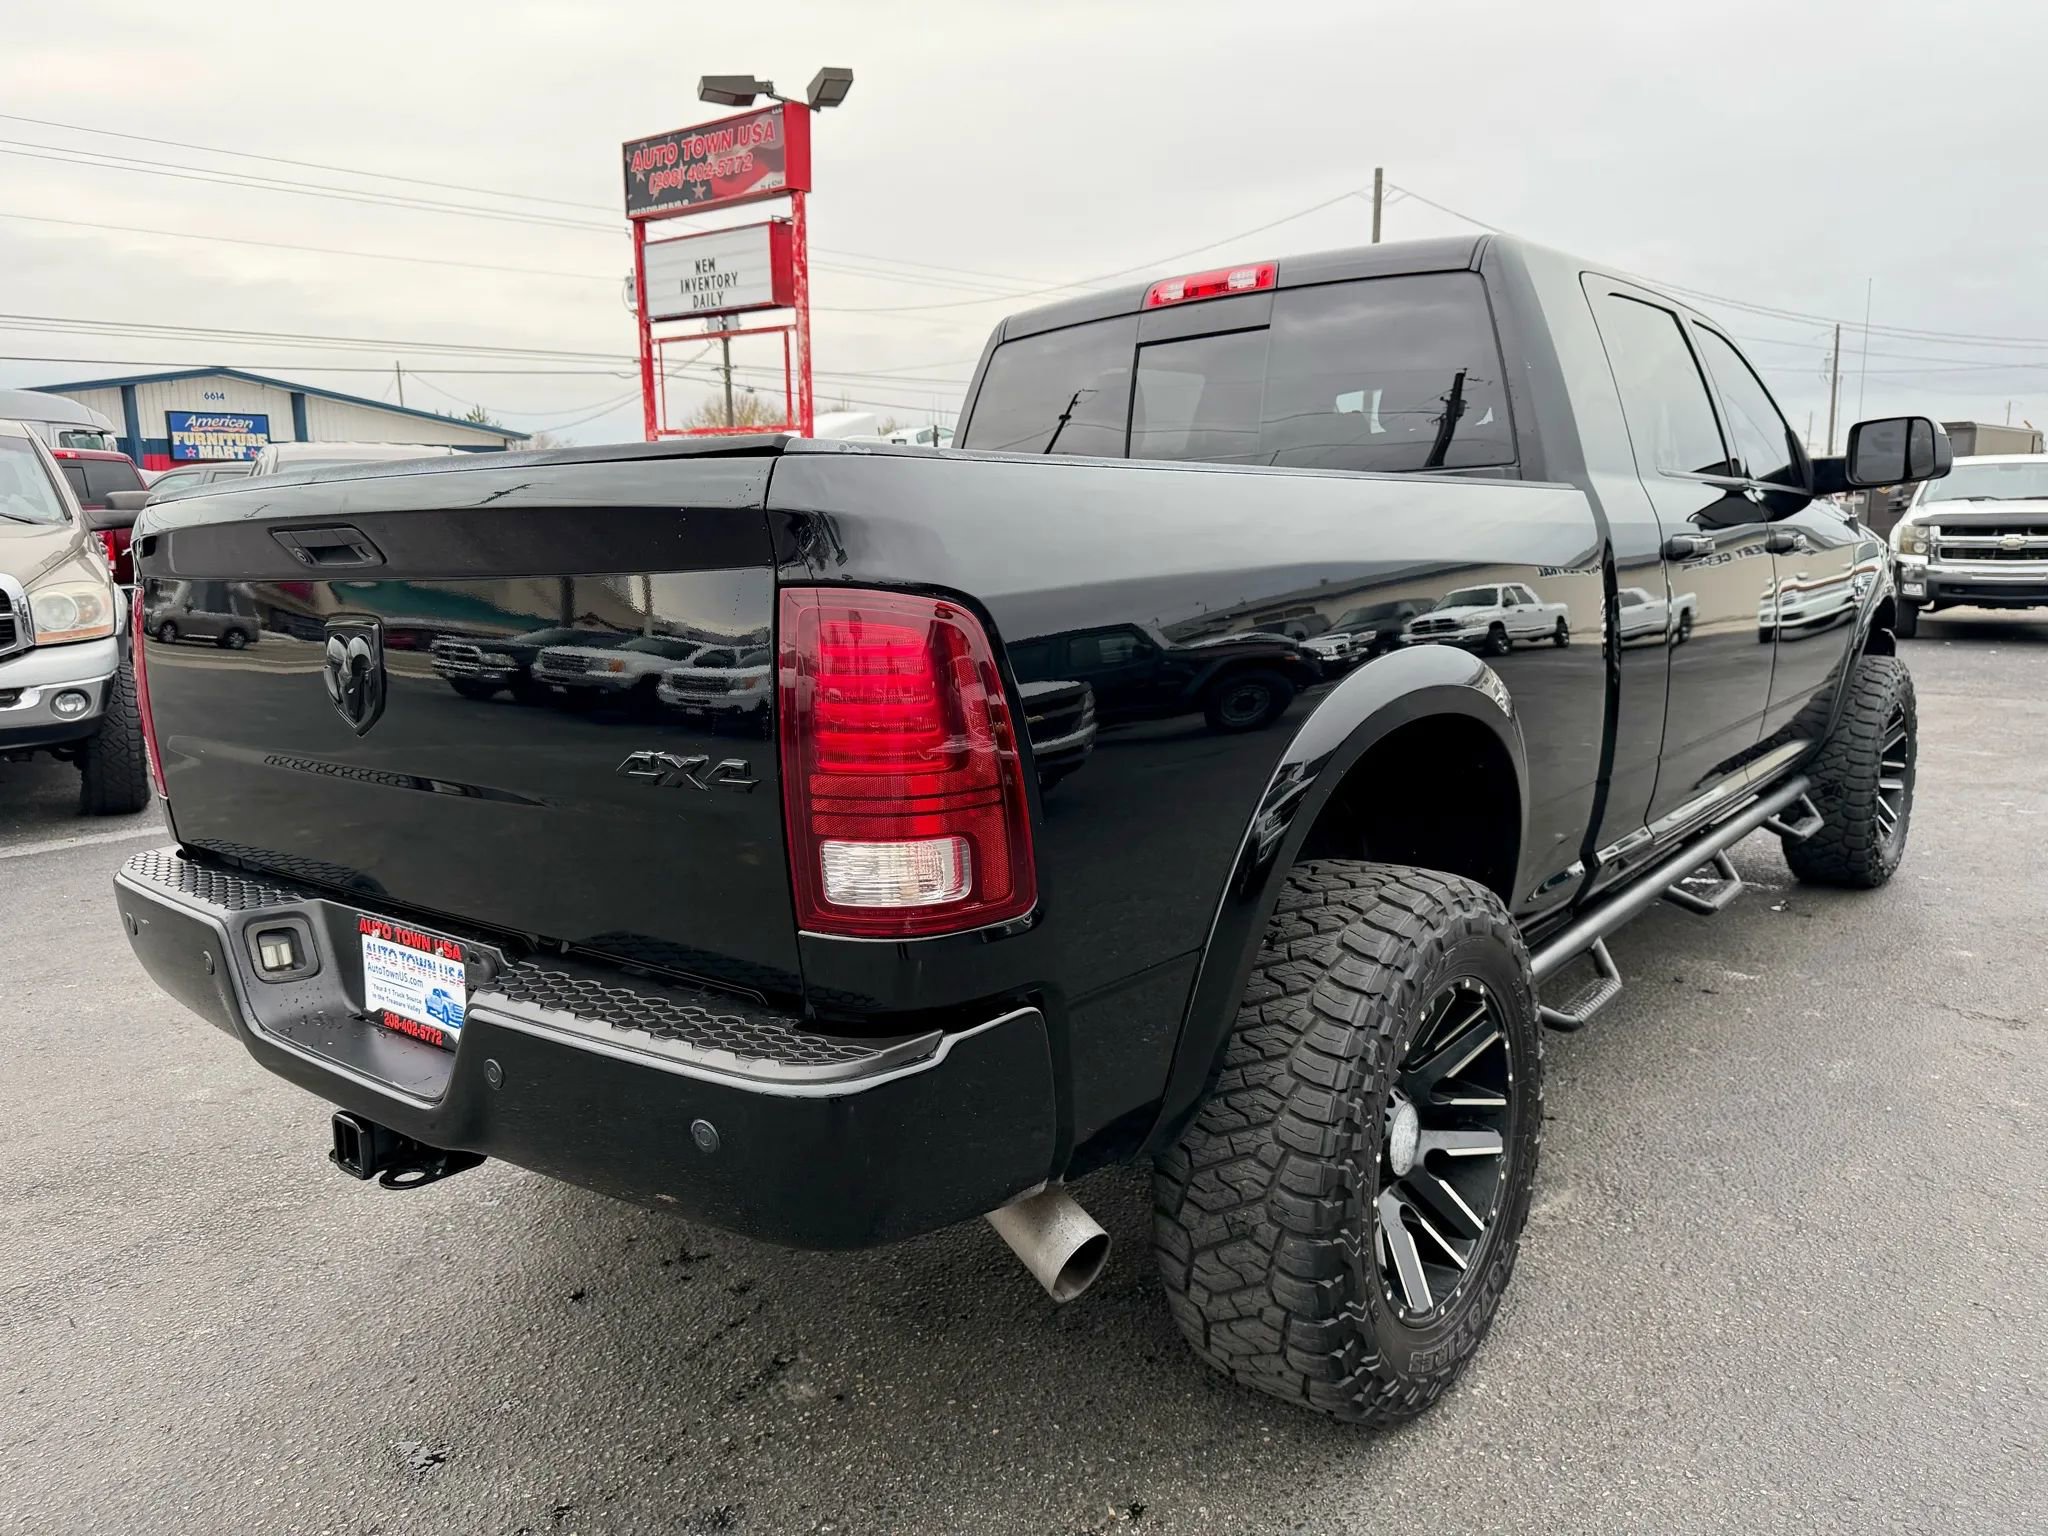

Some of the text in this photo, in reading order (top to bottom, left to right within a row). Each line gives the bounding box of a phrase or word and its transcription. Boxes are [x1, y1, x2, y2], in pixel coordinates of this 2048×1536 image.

[631, 119, 776, 172] AUTO TOWN USA
[648, 152, 754, 195] (208) 402-5772
[694, 257, 716, 275] NEW
[680, 271, 738, 294] INVENTORY
[692, 290, 724, 309] DAILY
[204, 392, 225, 400] 6614
[185, 414, 254, 429] American
[172, 431, 269, 447] FURNITURE
[198, 446, 247, 459] MART
[359, 918, 462, 961] AUTO TOWN USA
[366, 942, 466, 987] AUTO TOWN USA
[392, 989, 405, 998] Truck
[383, 1011, 443, 1046] 208-402-5772
[1409, 1324, 1471, 1374] TIRES
